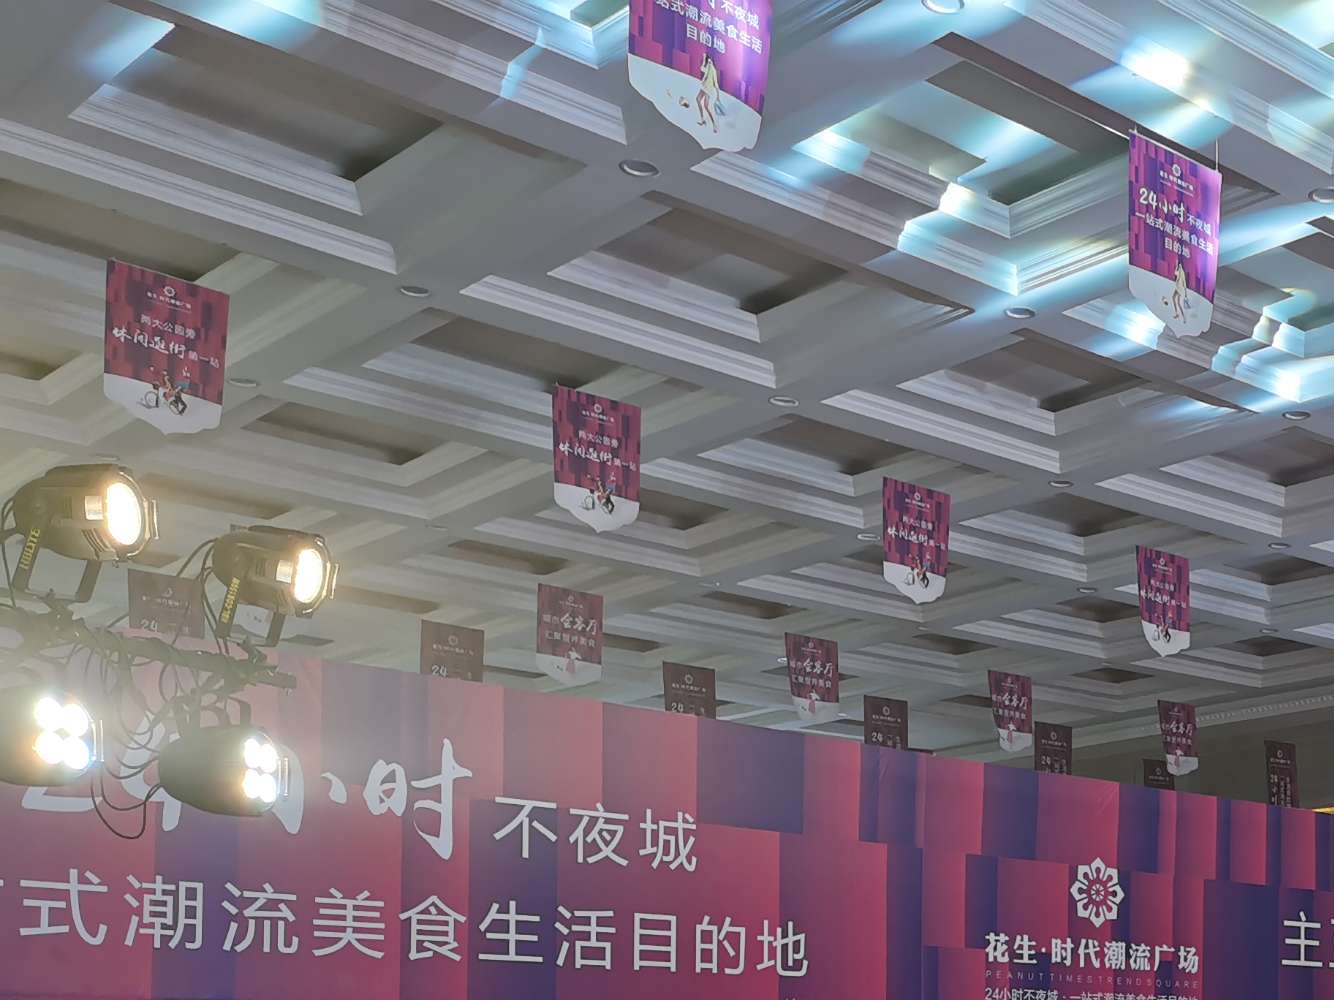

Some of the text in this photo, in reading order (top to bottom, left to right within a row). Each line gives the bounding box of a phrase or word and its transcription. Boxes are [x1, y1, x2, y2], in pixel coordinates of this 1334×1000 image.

[686, 23, 726, 54] 目的地
[0, 868, 810, 978] 式潮流美食生活目的地
[1049, 973, 1093, 985] TIMES
[1099, 975, 1142, 987] TREND
[1146, 977, 1199, 989] SQUARE
